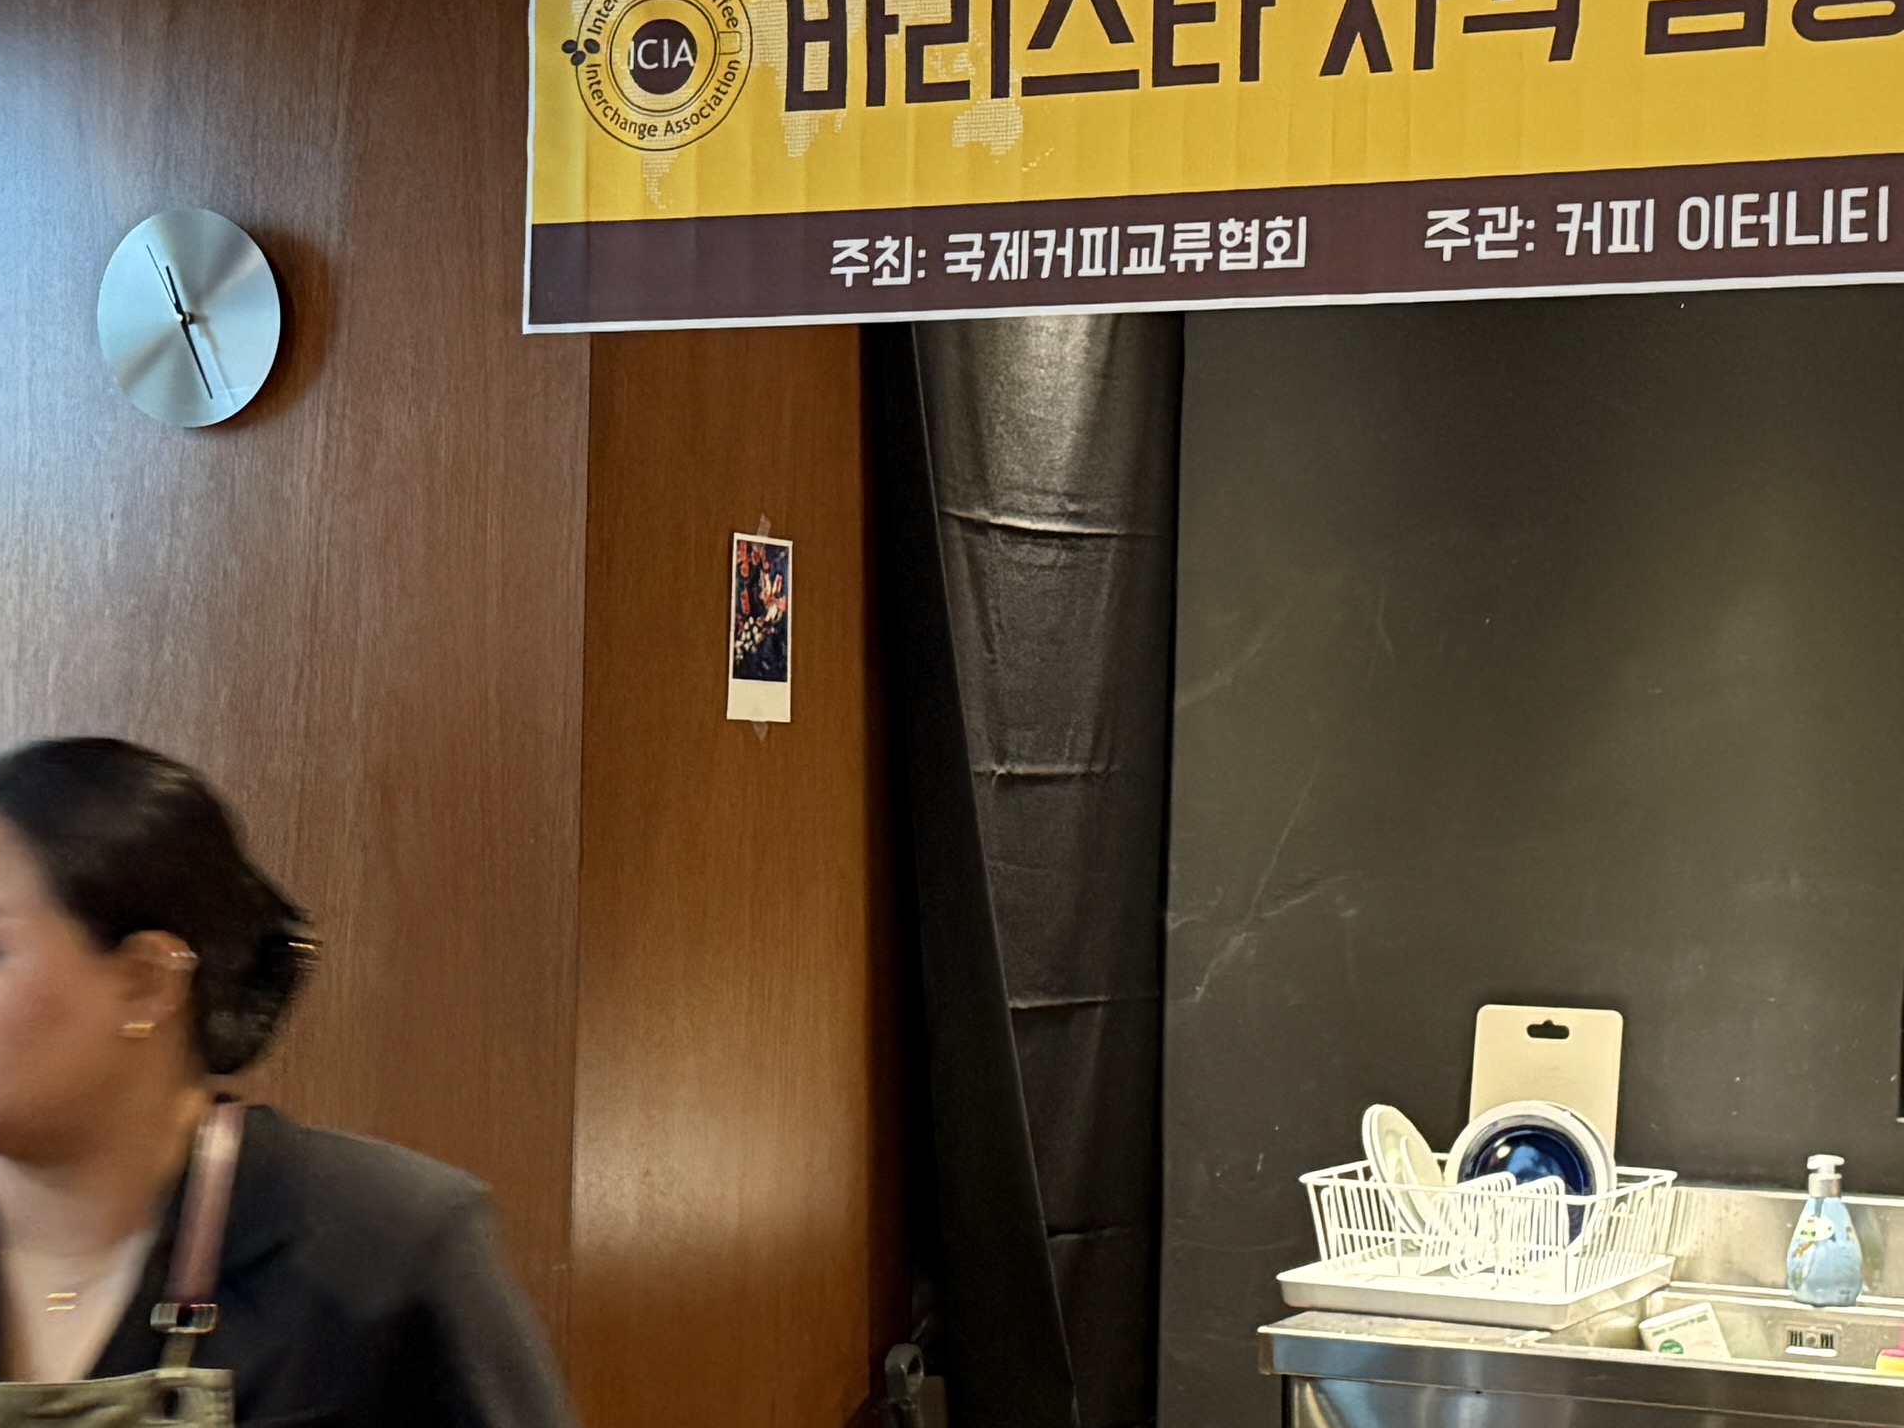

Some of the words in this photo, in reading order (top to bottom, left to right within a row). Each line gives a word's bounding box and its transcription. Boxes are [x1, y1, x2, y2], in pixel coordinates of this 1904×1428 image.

[629, 38, 695, 71] ICIA
[585, 62, 659, 140] Interchange
[662, 59, 742, 137] Association
[830, 235, 926, 288] 주최:
[944, 215, 1307, 282] 국제커피교류협회
[1424, 205, 1536, 262] 주관:
[1556, 198, 1655, 256] 커피
[1678, 185, 1889, 251] 이터니티
